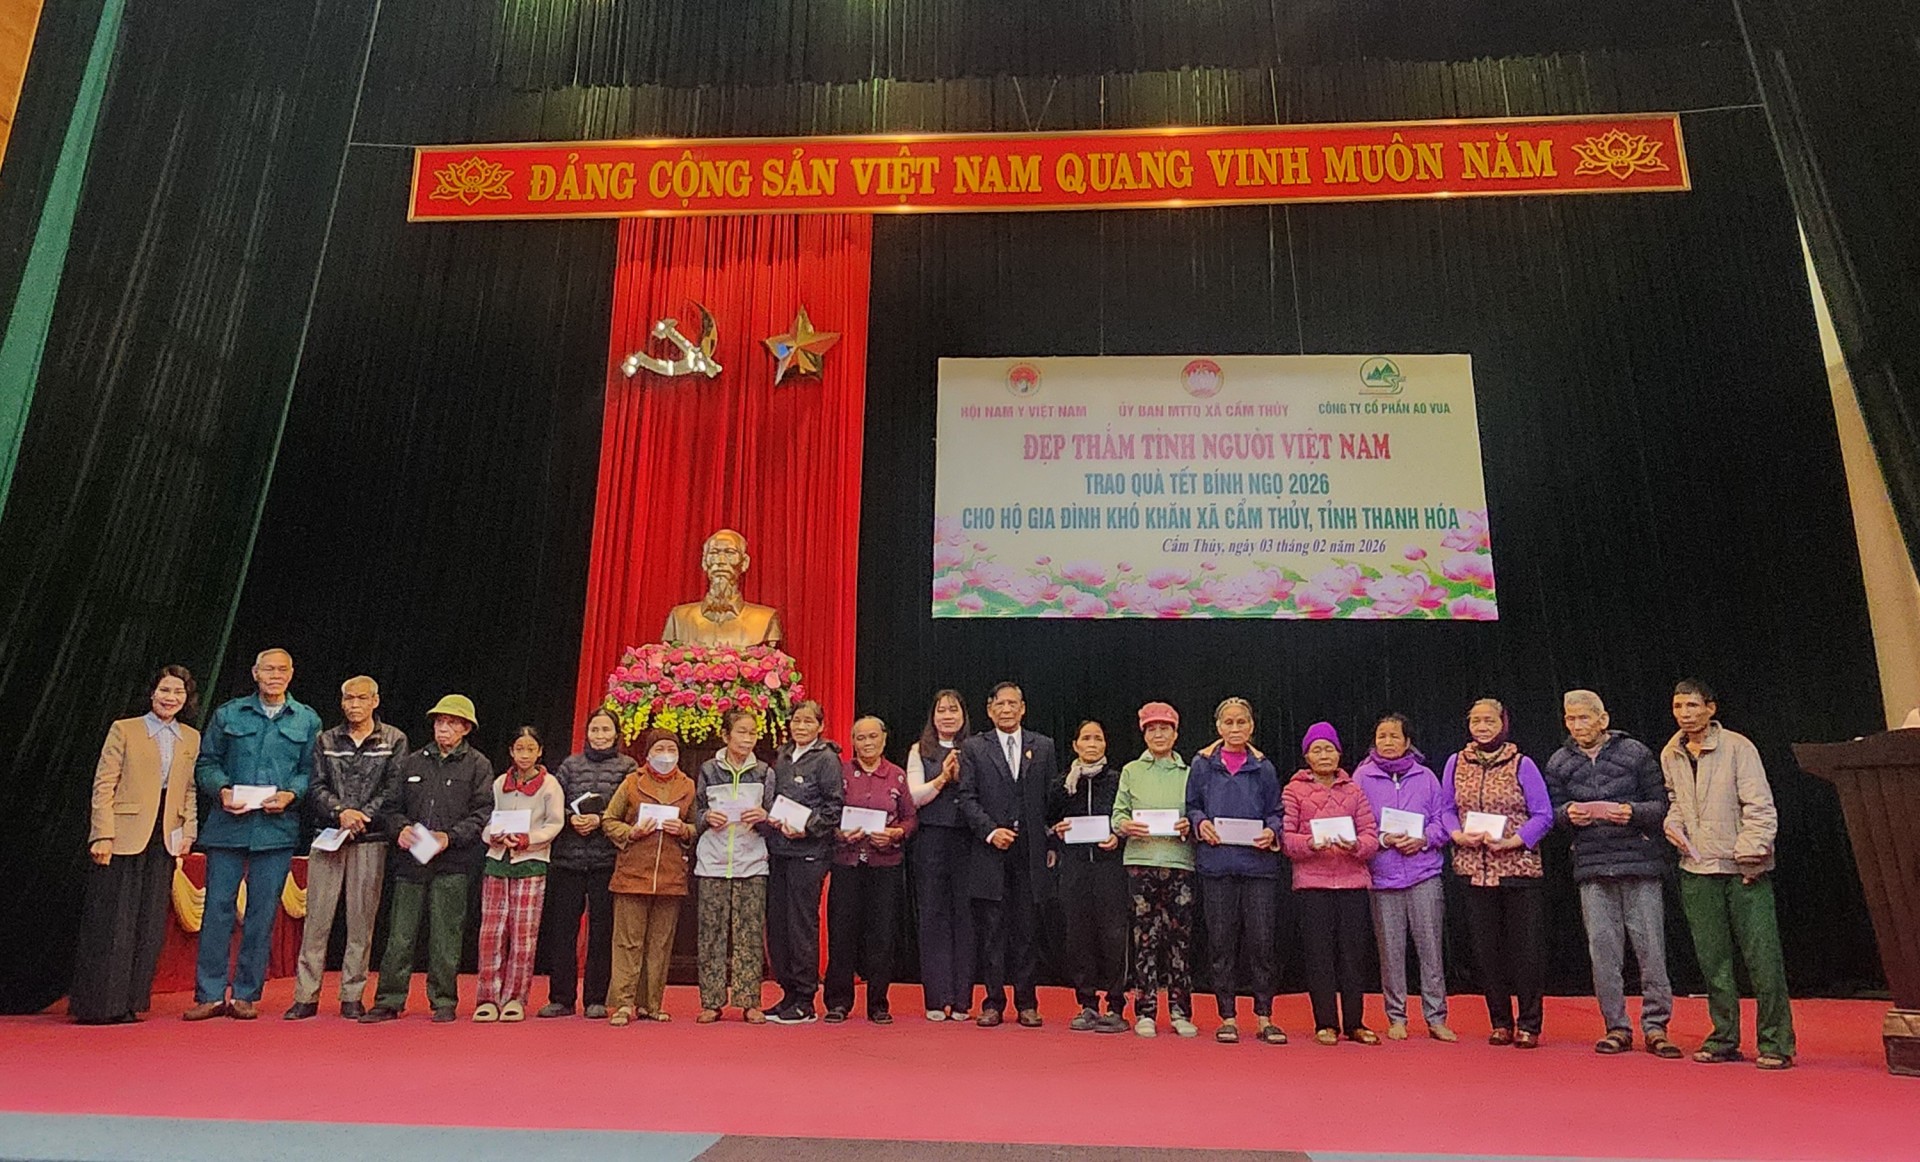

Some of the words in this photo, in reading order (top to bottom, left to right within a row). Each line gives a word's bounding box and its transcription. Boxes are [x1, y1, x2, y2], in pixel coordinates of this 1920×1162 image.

[528, 152, 637, 201] ĐẢNG
[649, 149, 753, 209] CỘNG
[762, 148, 838, 198] SẢN
[850, 145, 940, 205] VIỆT
[953, 154, 1043, 195] NAM
[1056, 150, 1195, 195] QUANG
[1207, 147, 1311, 187] VINH
[1323, 133, 1444, 183] MUÔN
[1458, 131, 1558, 180] NĂM
[985, 405, 1014, 418] NAM
[1018, 405, 1025, 418] Y
[1029, 403, 1055, 420] VIỆT
[1058, 405, 1087, 418] NAM
[1138, 405, 1164, 417] BAN
[1168, 404, 1201, 418] MTTQ
[1205, 401, 1222, 417] XÃ
[1318, 401, 1347, 415] CÔNG
[1349, 403, 1361, 414] TY
[1413, 402, 1427, 414] AO
[1430, 402, 1451, 414] VUA
[1023, 433, 1066, 466] ĐẸP
[1072, 422, 1135, 460] THẮM
[1141, 427, 1196, 460] TÌNH
[1201, 427, 1275, 460] NGƯỜI
[1280, 427, 1333, 465] VIỆT
[1338, 433, 1392, 460] NAM
[1084, 472, 1126, 495] TRAO
[1131, 467, 1165, 497] QUÀ
[1169, 465, 1198, 495] TẾT
[1203, 467, 1243, 495] BÍNH
[1248, 472, 1283, 500] NGỌ
[1289, 472, 1330, 495] 2026
[962, 506, 995, 530] CHO
[1000, 502, 1022, 534] HỘ
[1027, 506, 1056, 530] GIA
[1060, 502, 1101, 530] ĐÌNH
[1106, 502, 1140, 530] KHÓ
[1145, 502, 1191, 530] KHĂN
[1196, 502, 1220, 530] XÃ
[1225, 497, 1263, 530] CẨM
[1268, 499, 1313, 532] THỦY,
[1318, 499, 1357, 530] TỈNH
[1361, 506, 1419, 530] THANH
[1425, 502, 1461, 530] HÓA
[1228, 539, 1255, 556] ngày
[1259, 538, 1273, 553] 03
[1276, 538, 1310, 556] tháng
[1312, 539, 1327, 553] 02
[1329, 539, 1355, 553] năm
[1358, 538, 1386, 553] 2026
